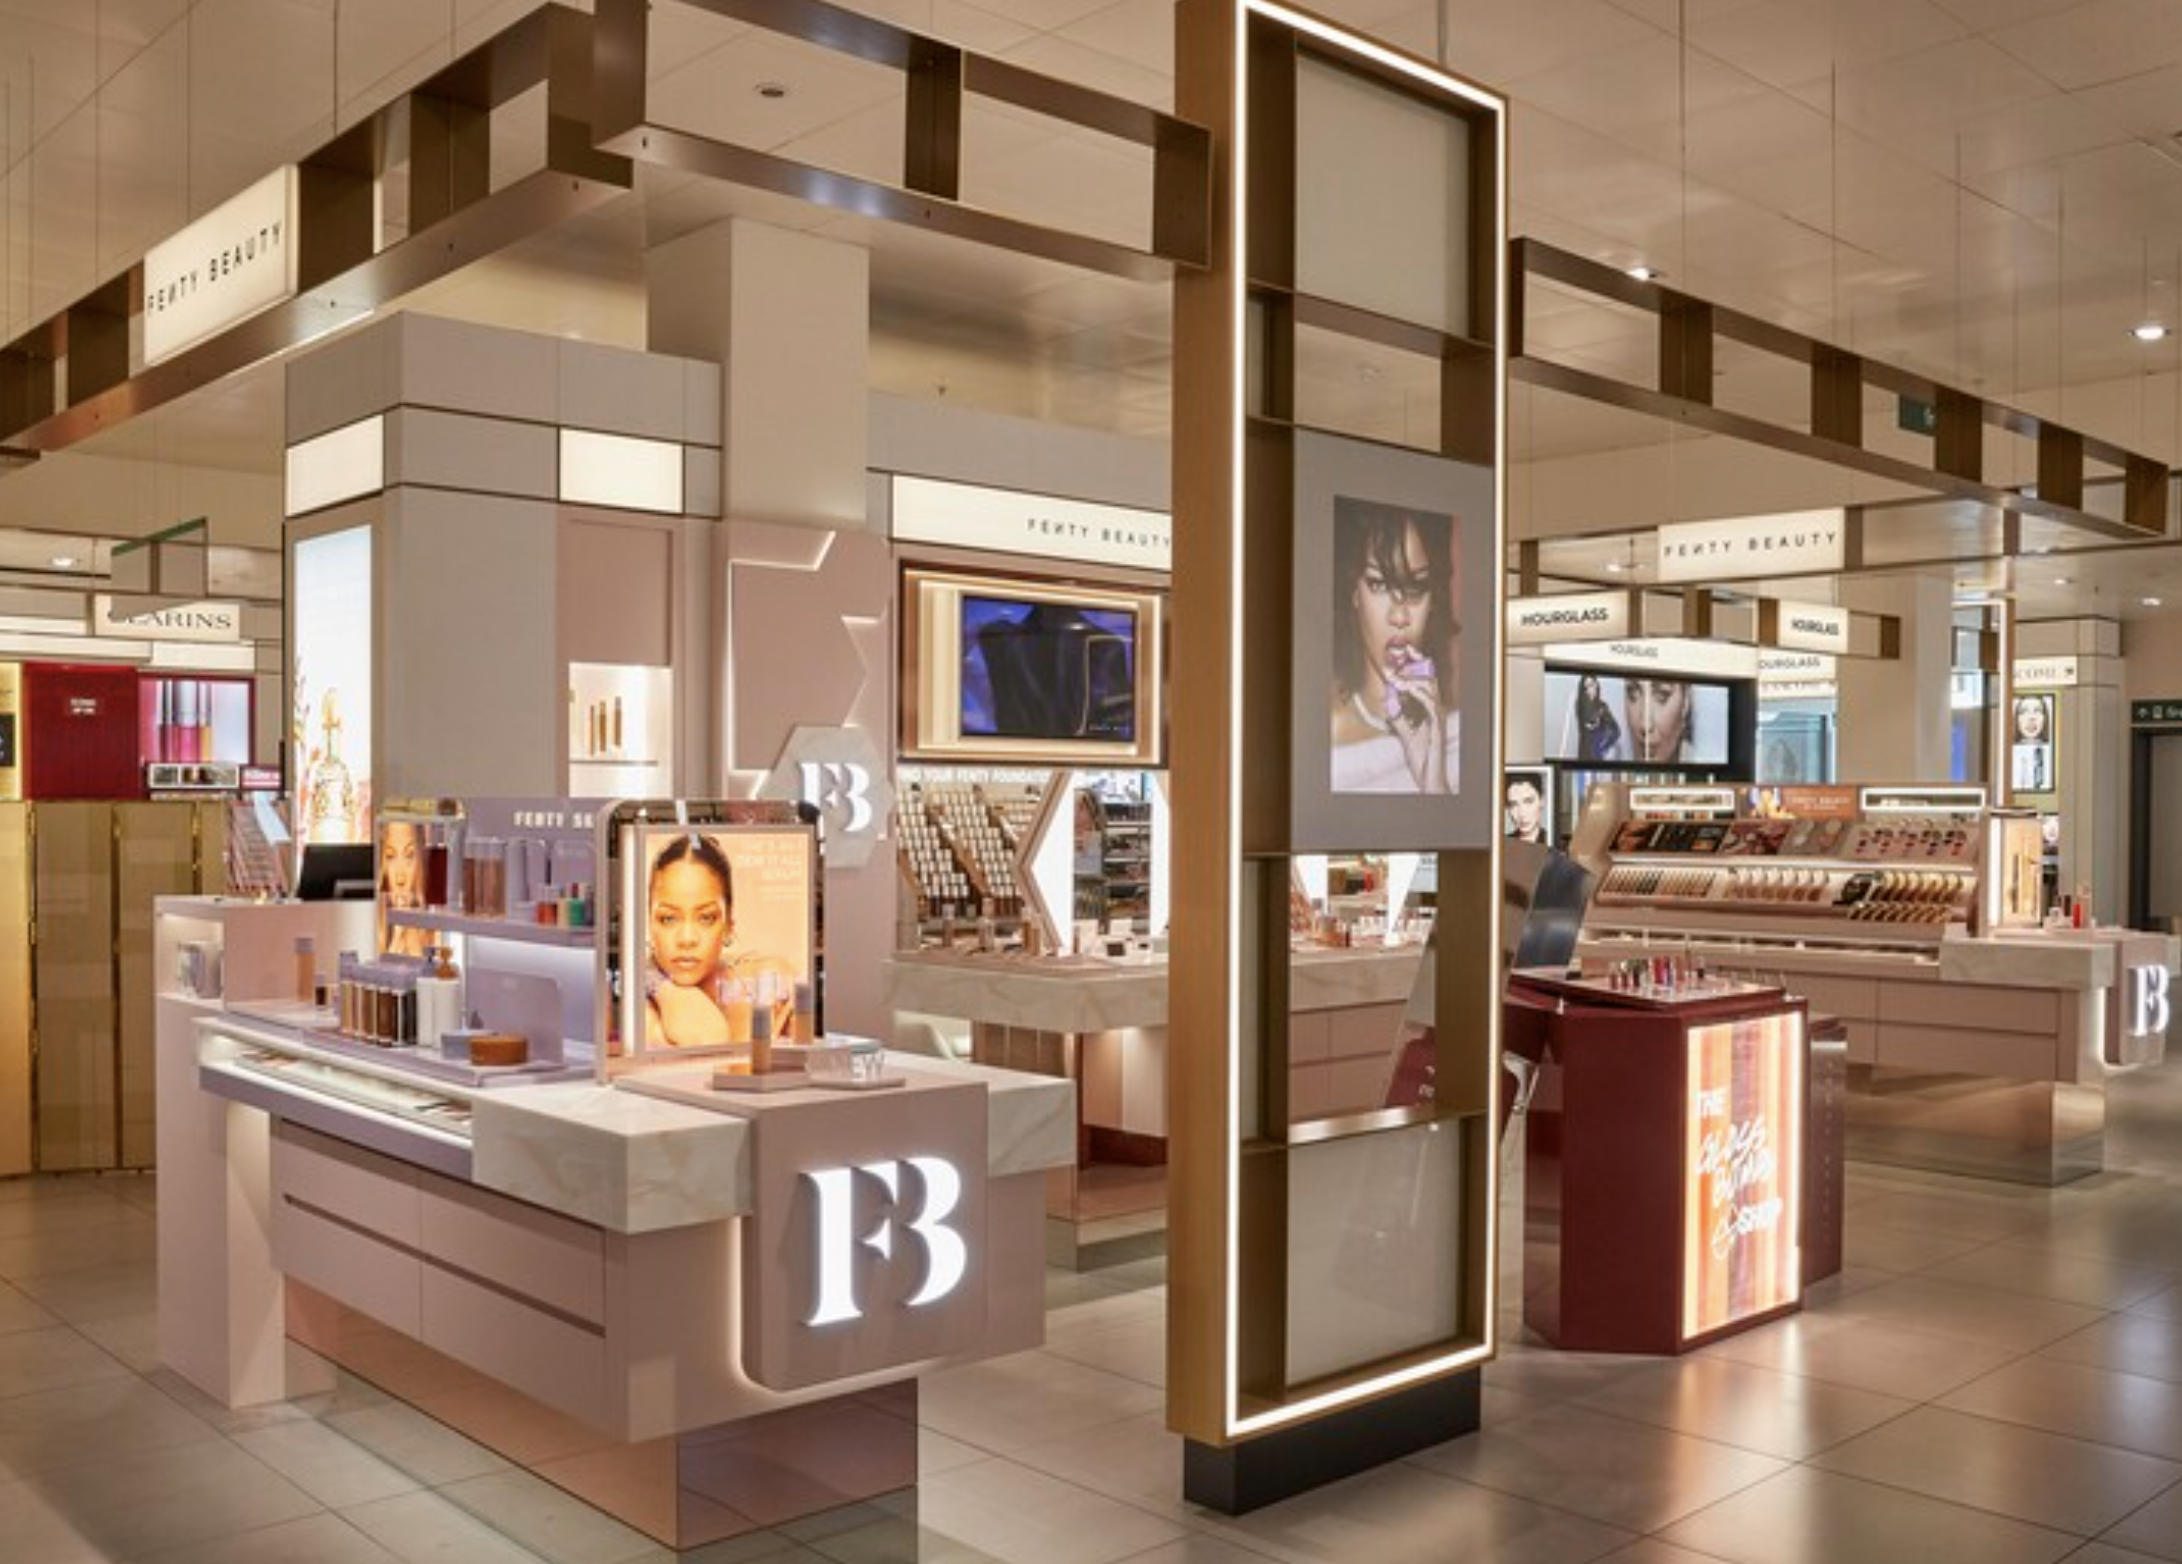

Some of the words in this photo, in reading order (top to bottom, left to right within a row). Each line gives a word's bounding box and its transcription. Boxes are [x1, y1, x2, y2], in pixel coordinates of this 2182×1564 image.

[210, 221, 282, 282] BEAUTY
[1101, 527, 1170, 547] BEAUTY
[1748, 531, 1837, 550] BEAUTY
[1521, 607, 1609, 626] HOURGLASS
[805, 1156, 968, 1328] FB
